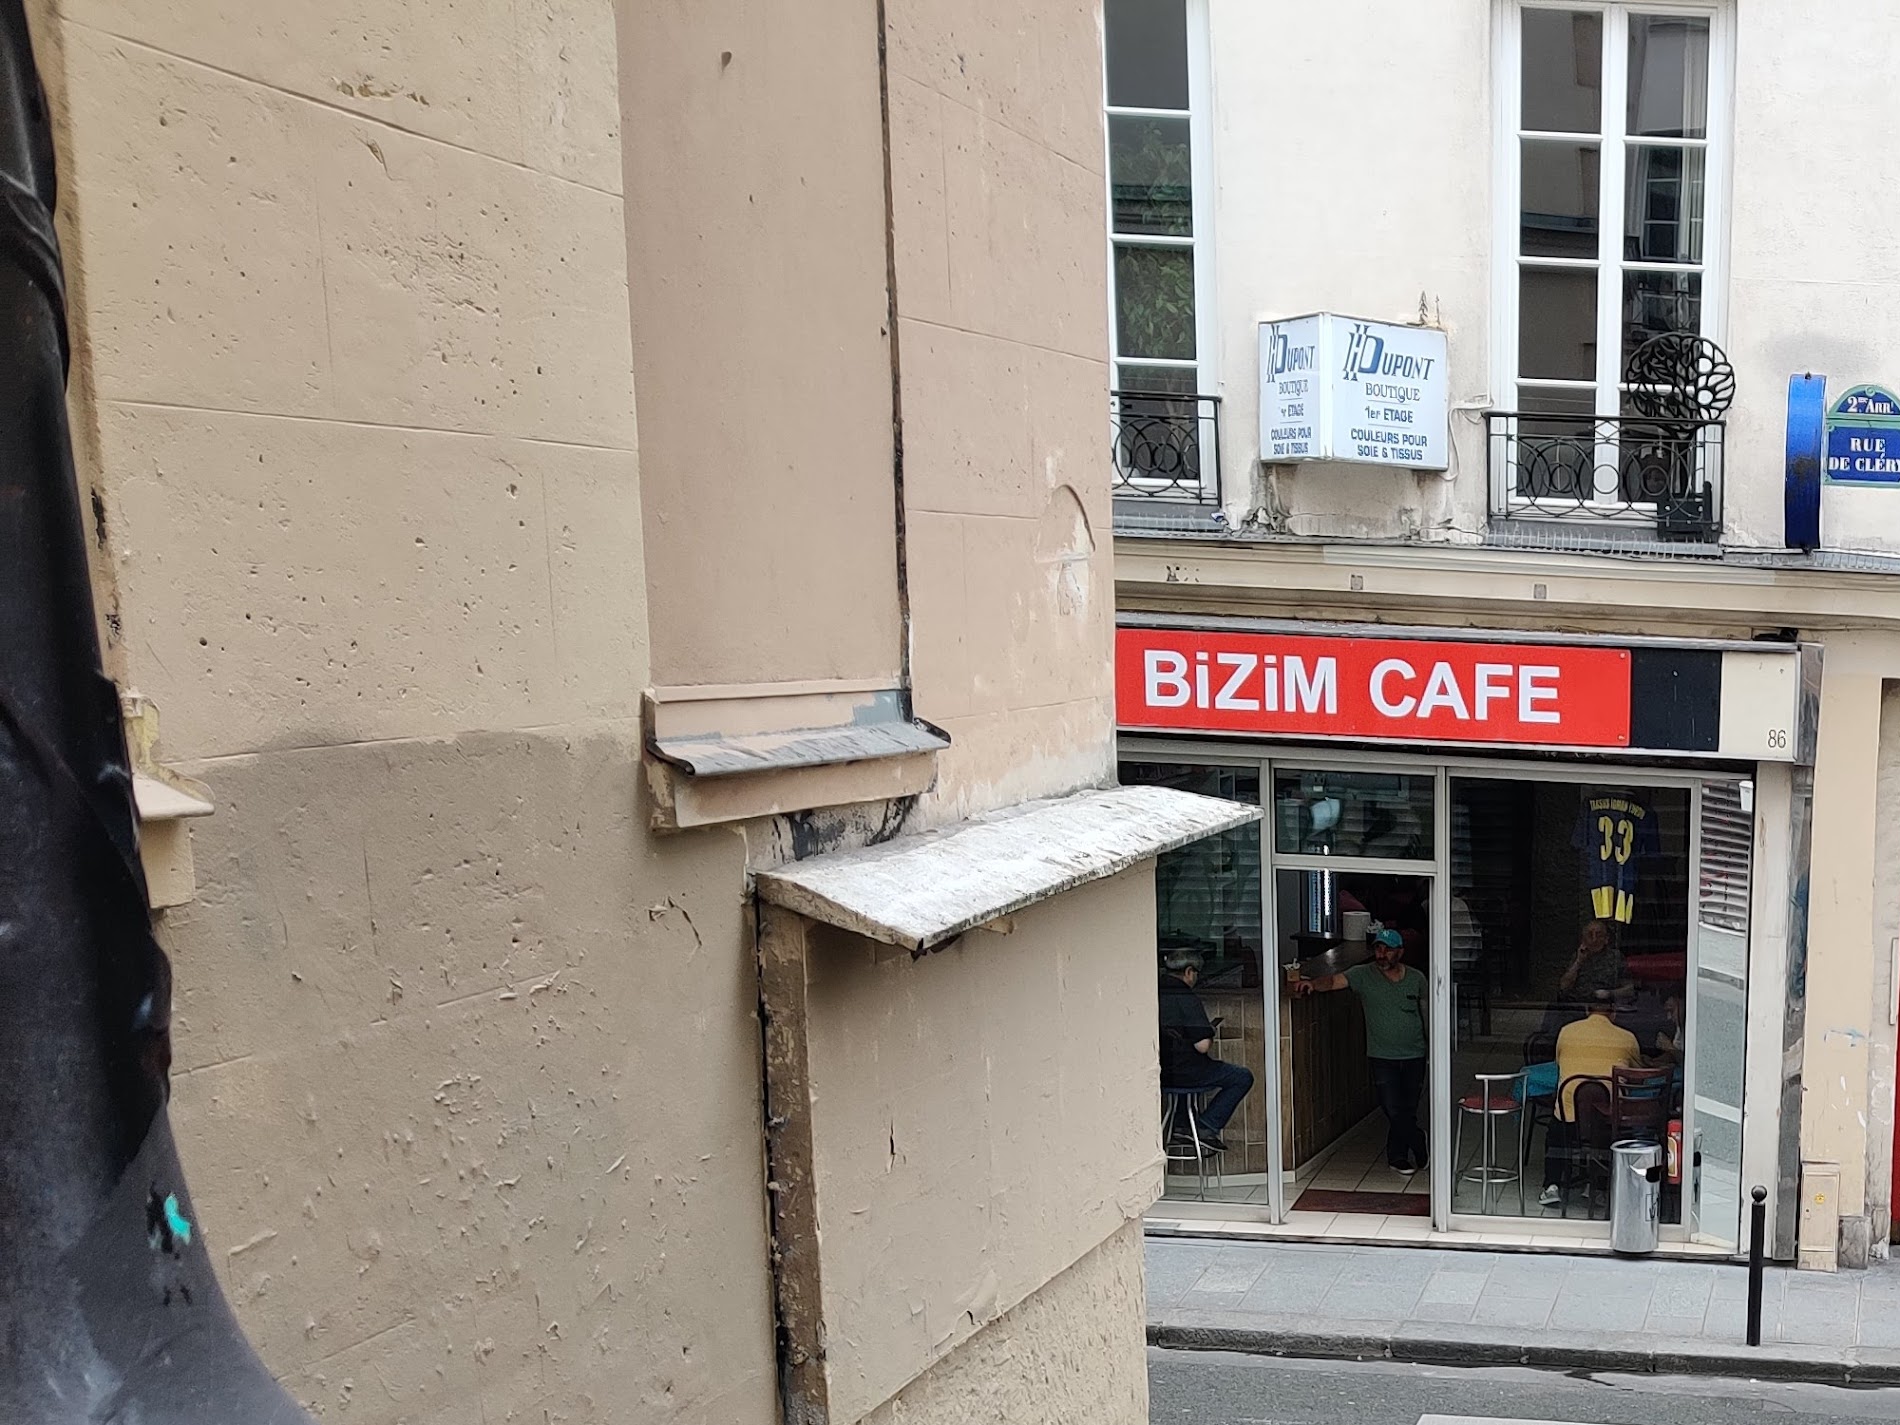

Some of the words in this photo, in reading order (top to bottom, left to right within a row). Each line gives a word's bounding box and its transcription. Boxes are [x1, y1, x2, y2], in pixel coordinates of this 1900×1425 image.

[1365, 382, 1420, 403] BOUTIQUE
[1365, 405, 1381, 420] 1er
[1383, 408, 1413, 423] ETAGE
[1351, 428, 1399, 444] COULEURS
[1402, 433, 1428, 447] POUR
[1850, 437, 1885, 452] RUE
[1357, 444, 1379, 457] SOIE
[1382, 446, 1388, 458] &
[1391, 447, 1423, 461] TISSUS
[1828, 456, 1850, 471] DE
[1144, 649, 1337, 714] BiZiM
[1369, 658, 1560, 724] CAFE
[1768, 729, 1786, 748] 86
[1598, 815, 1633, 865] 33
